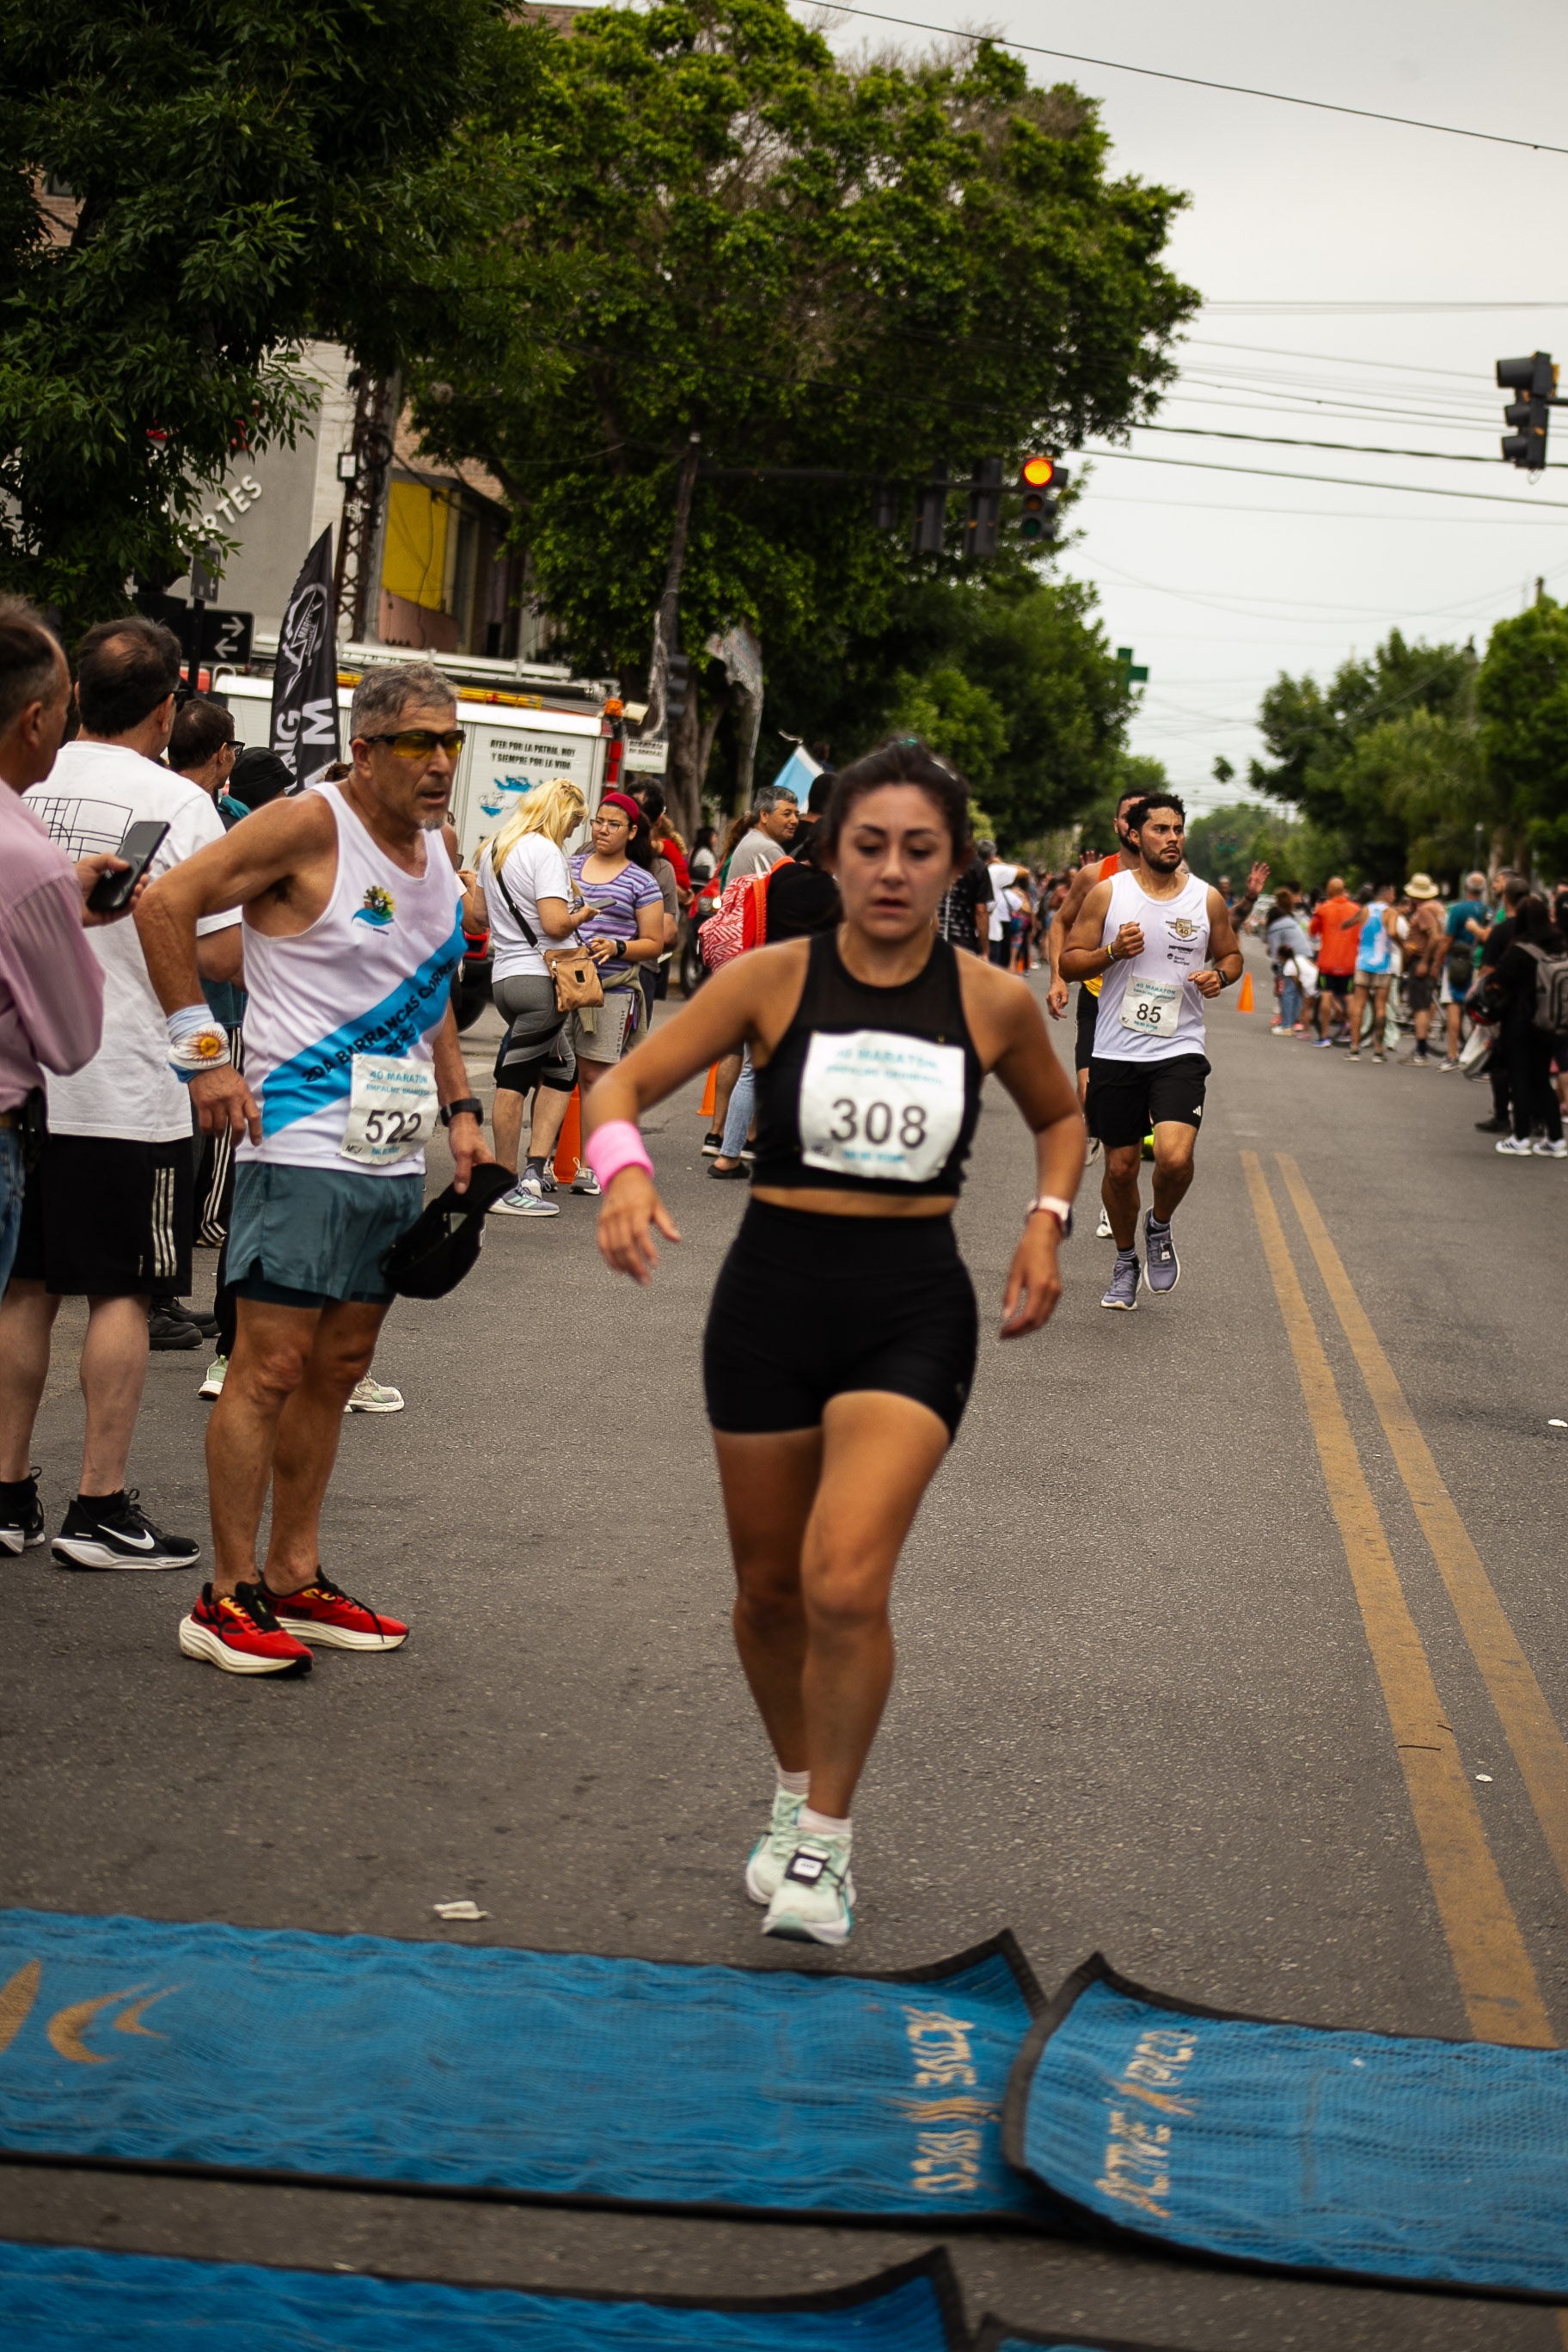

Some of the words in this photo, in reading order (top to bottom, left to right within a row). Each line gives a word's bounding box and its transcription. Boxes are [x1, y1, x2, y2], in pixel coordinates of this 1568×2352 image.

[490, 739, 506, 749] AYER
[509, 742, 523, 751] POR
[524, 743, 532, 752] LA
[560, 748, 576, 757] HOY
[492, 752, 497, 762] Y
[497, 753, 528, 765] SIEMPRE
[529, 756, 543, 766] POR
[544, 759, 553, 768] LA
[554, 760, 572, 770] VIDA
[1145, 983, 1176, 995] MARATON
[334, 994, 420, 1067] BARRANCAS
[418, 956, 456, 1000] CORRE
[1136, 1002, 1162, 1024] 85
[370, 1070, 383, 1081] 40
[387, 1072, 428, 1083] MARATON
[366, 1083, 401, 1093] EMPALME
[365, 1109, 422, 1144] 522
[830, 1097, 927, 1150] 308
